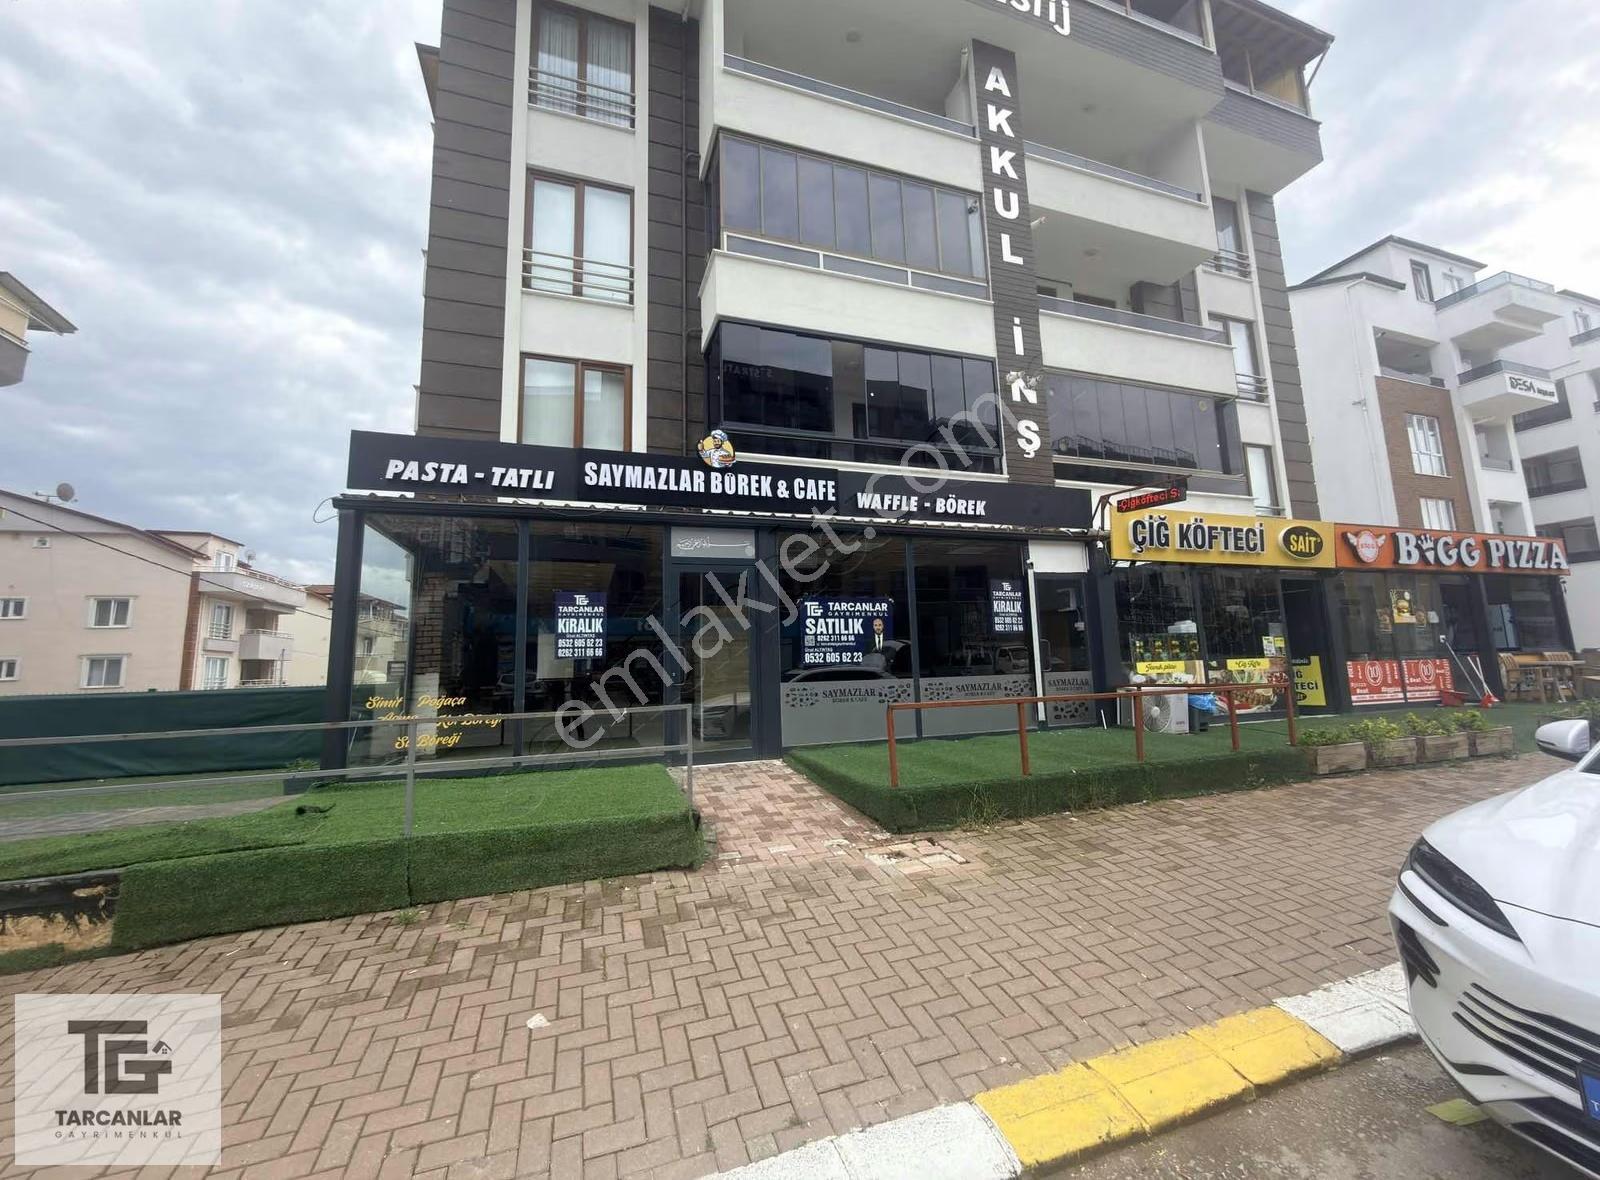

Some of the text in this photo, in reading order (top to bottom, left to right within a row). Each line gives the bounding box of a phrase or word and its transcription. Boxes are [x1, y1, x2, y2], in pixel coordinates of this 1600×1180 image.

[984, 65, 1024, 266] AKKUL
[385, 458, 468, 484] PASTA
[490, 465, 556, 491] TATLI
[584, 461, 837, 502] SAYMAZLAR BÖREK & CAFE
[856, 492, 919, 512] WAFFLE
[935, 494, 986, 516] BÖREK
[1131, 514, 1265, 553] ÇİĞ KÖFTECİ
[1290, 532, 1317, 554] SAİT
[1487, 539, 1570, 570] PIZZA
[828, 602, 889, 611] TARCANLAR
[558, 618, 604, 634] KİRALIK
[805, 618, 864, 635] SATILIK
[804, 651, 864, 664] 0532 605 62 23
[822, 688, 876, 698] SAYMAZLAR
[956, 682, 1002, 692] SAYMAZLAR
[416, 693, 467, 710] Poğaça
[415, 732, 463, 748] Böreği
